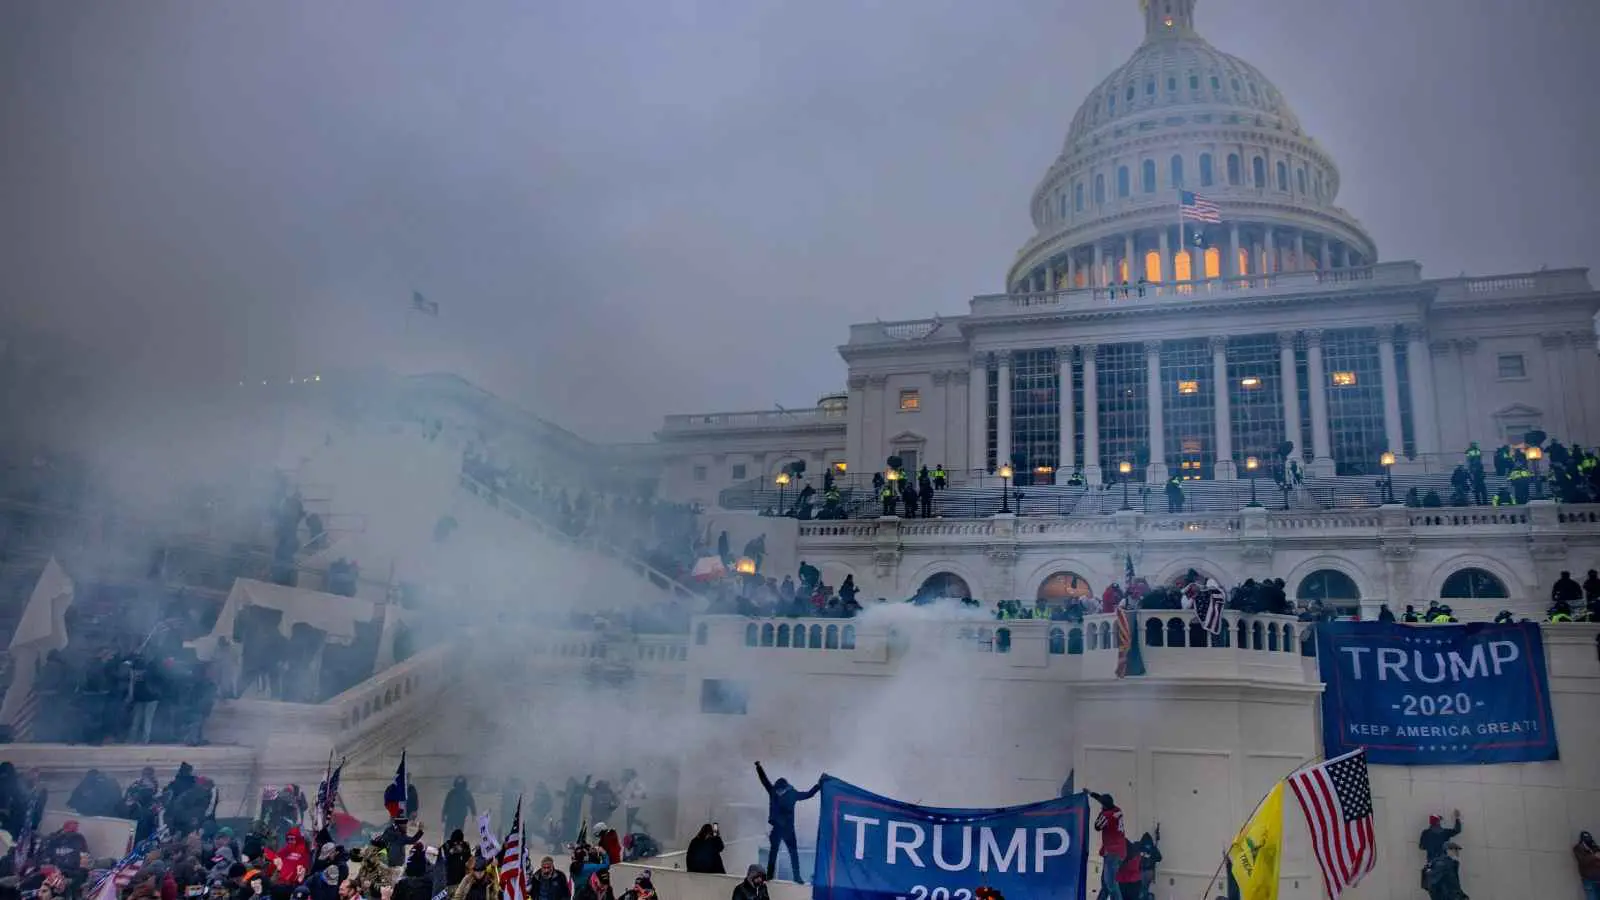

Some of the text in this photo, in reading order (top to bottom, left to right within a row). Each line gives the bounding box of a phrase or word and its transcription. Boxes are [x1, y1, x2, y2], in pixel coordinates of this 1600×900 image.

[1340, 640, 1520, 684] TRUMP
[1391, 692, 1485, 716] -2020-
[1350, 720, 1538, 738] KEEP AMERICA GREAT!
[843, 814, 1071, 873] TRUMP
